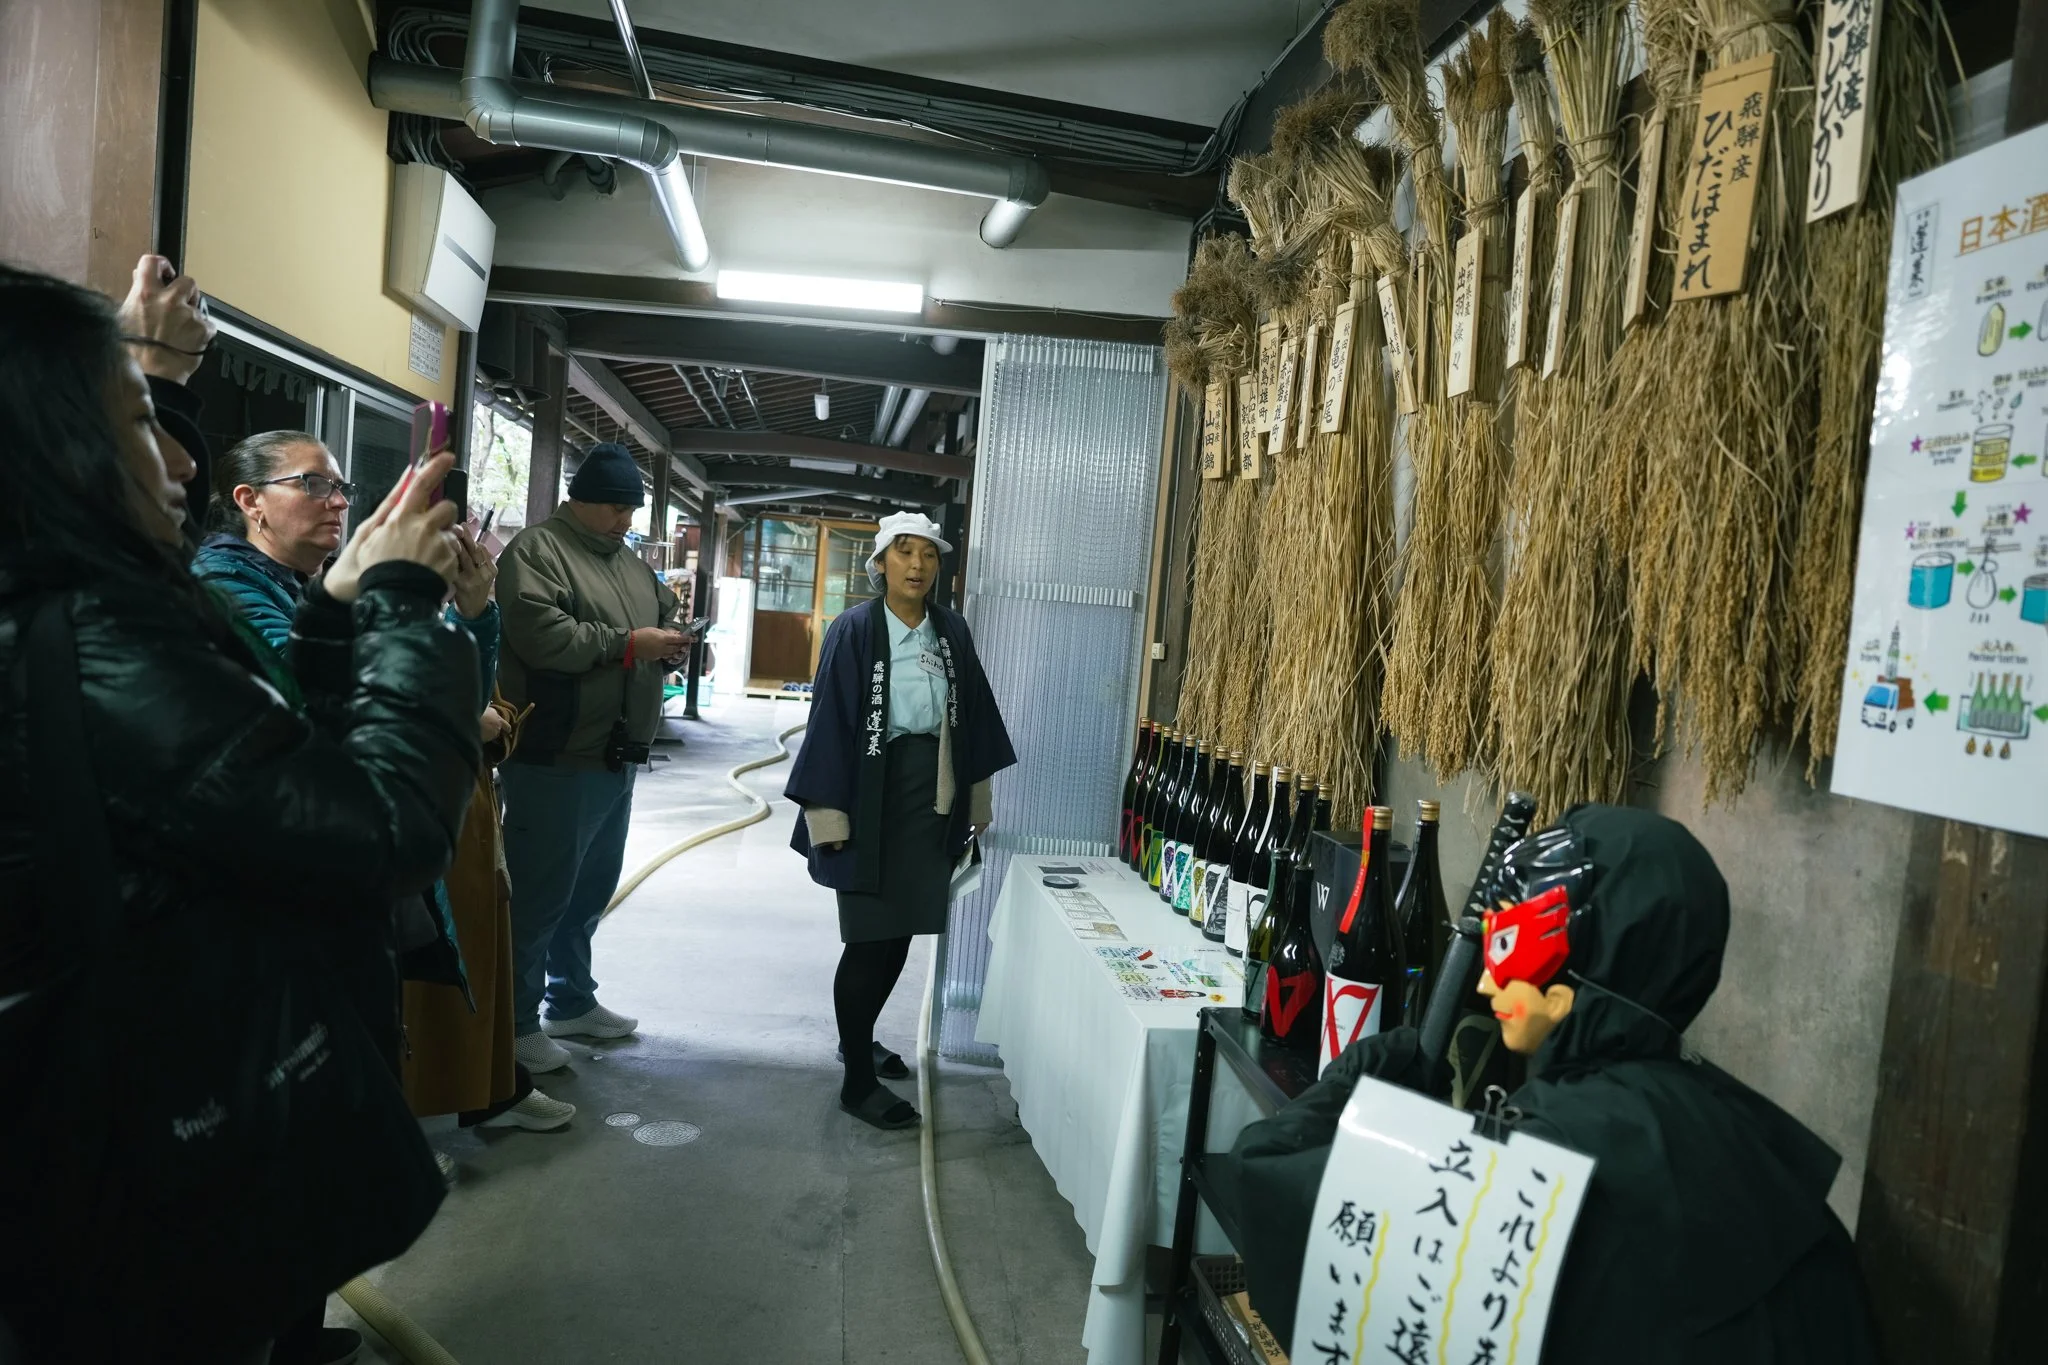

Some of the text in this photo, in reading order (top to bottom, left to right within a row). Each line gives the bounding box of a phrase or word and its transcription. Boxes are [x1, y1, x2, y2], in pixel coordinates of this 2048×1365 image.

[1728, 91, 1763, 184] 飛騨産
[1680, 109, 1734, 292] ひだほまれ
[1323, 339, 1341, 424] 亀の尾
[1203, 410, 1215, 473] 山田錦
[871, 660, 885, 706] 飛騨の酒
[919, 653, 944, 672] Shiho
